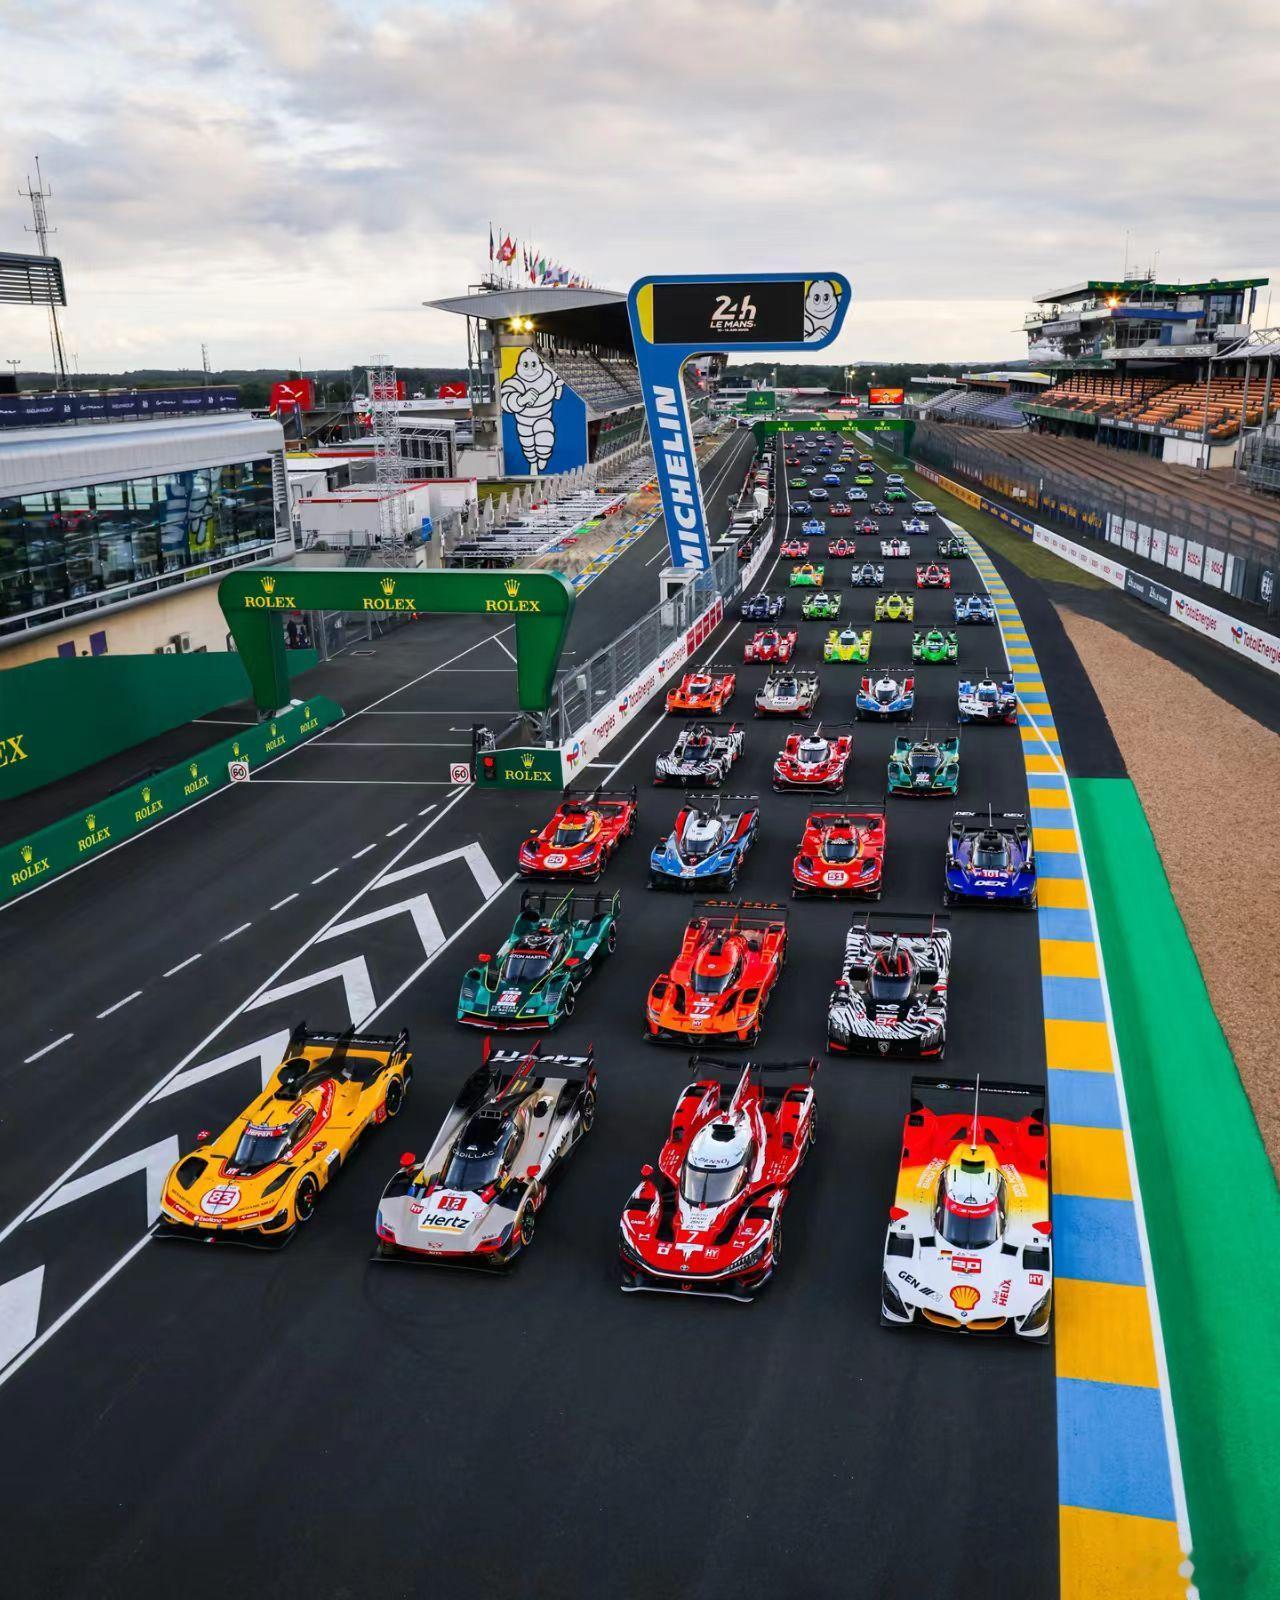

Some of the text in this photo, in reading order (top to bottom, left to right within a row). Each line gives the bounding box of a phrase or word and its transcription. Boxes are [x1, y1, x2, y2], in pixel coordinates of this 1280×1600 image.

[652, 385, 704, 572] MICHELIN
[244, 596, 296, 608] ROLEX
[363, 598, 416, 610] ROLEX
[485, 600, 541, 612] ROLEX
[1185, 603, 1217, 631] TotalEnergies
[300, 717, 319, 734] ROLEX
[265, 735, 286, 752] ROLEX
[232, 768, 244, 776] 60
[454, 770, 466, 778] 60
[504, 770, 552, 781] ROLEX
[184, 775, 209, 795] ROLEX
[135, 800, 164, 822] ROLEX
[78, 827, 111, 851] ROLEX
[548, 856, 564, 864] 50
[11, 858, 50, 886] ROLEX
[246, 1128, 273, 1136] Ferrari
[210, 1191, 236, 1205] 83
[443, 1197, 461, 1210] 12
[410, 1205, 423, 1213] HY
[422, 1214, 470, 1229] Hertz
[687, 1231, 699, 1243] 7
[705, 1248, 718, 1257] HY
[953, 1261, 981, 1270] 20
[898, 1270, 920, 1289] GEN
[1029, 1274, 1043, 1286] HY
[992, 1290, 1000, 1304] Shell
[999, 1279, 1012, 1306] HELIX
